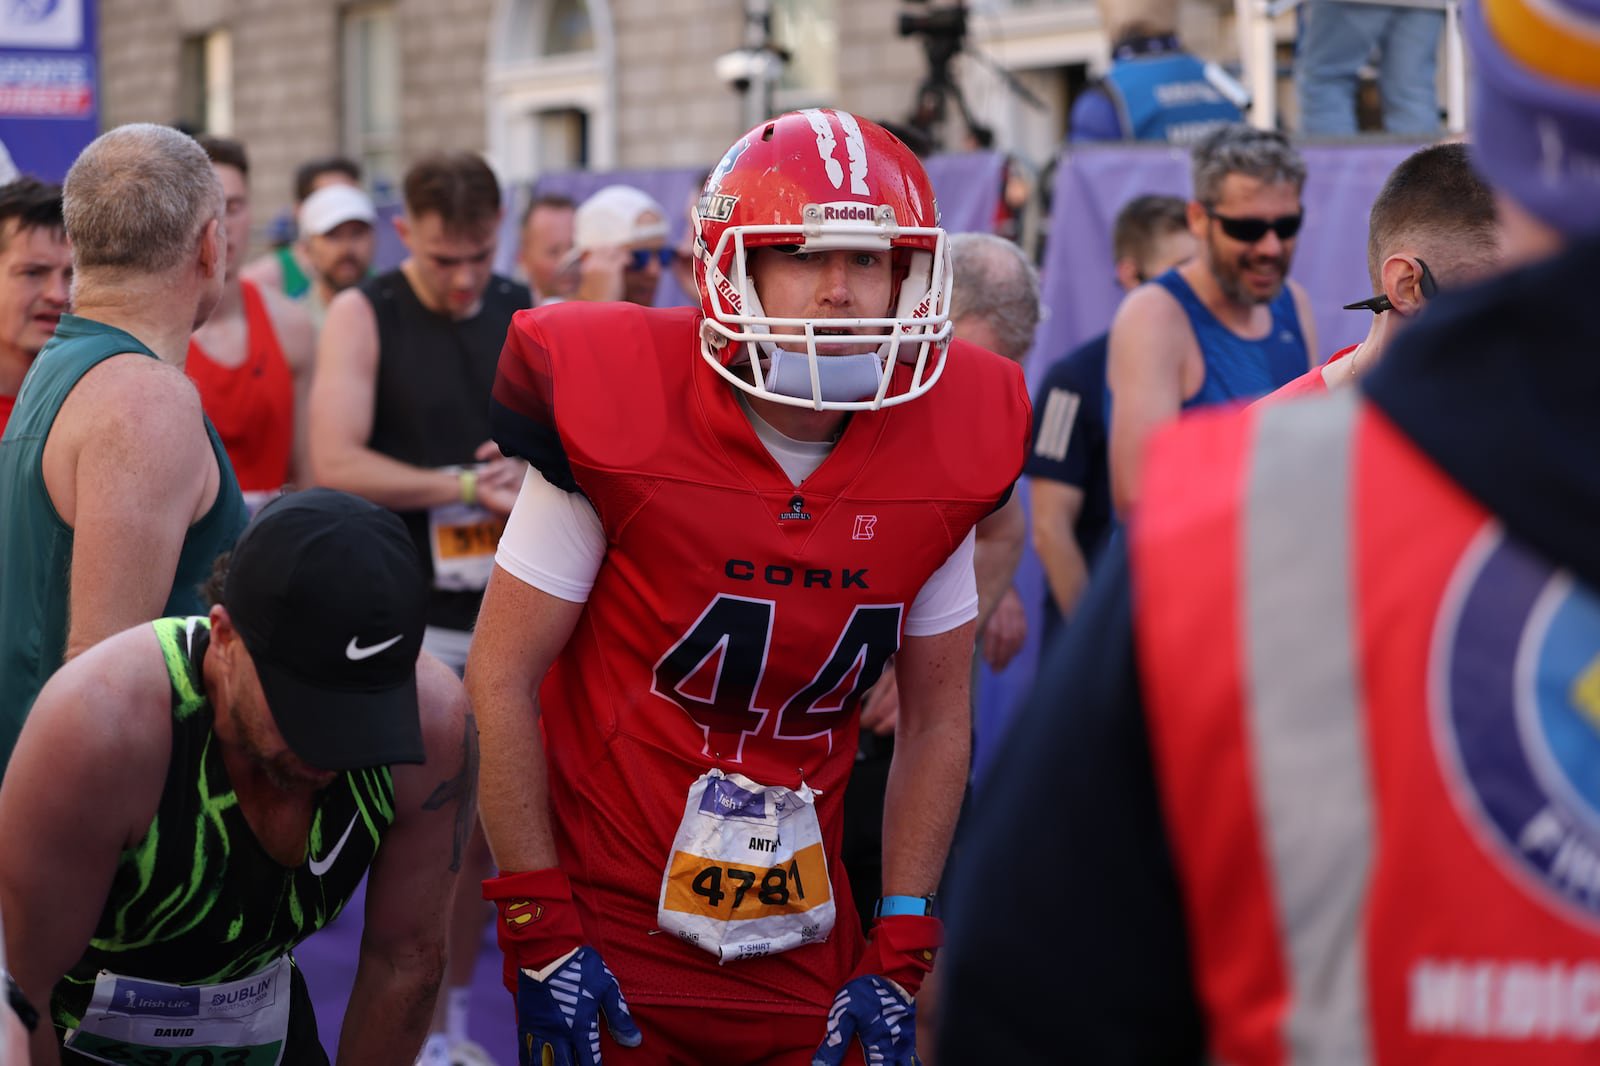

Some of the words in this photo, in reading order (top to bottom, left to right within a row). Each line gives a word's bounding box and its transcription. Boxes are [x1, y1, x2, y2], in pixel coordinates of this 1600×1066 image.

[824, 206, 875, 221] Riddell
[725, 559, 870, 589] CORK
[649, 592, 904, 763] 44
[691, 860, 805, 908] 4781
[738, 942, 771, 952] T-SHIRT
[211, 977, 271, 1006] DUBLIN
[139, 998, 166, 1008] Irish
[167, 999, 190, 1009] Life
[154, 1028, 195, 1038] DAVID
